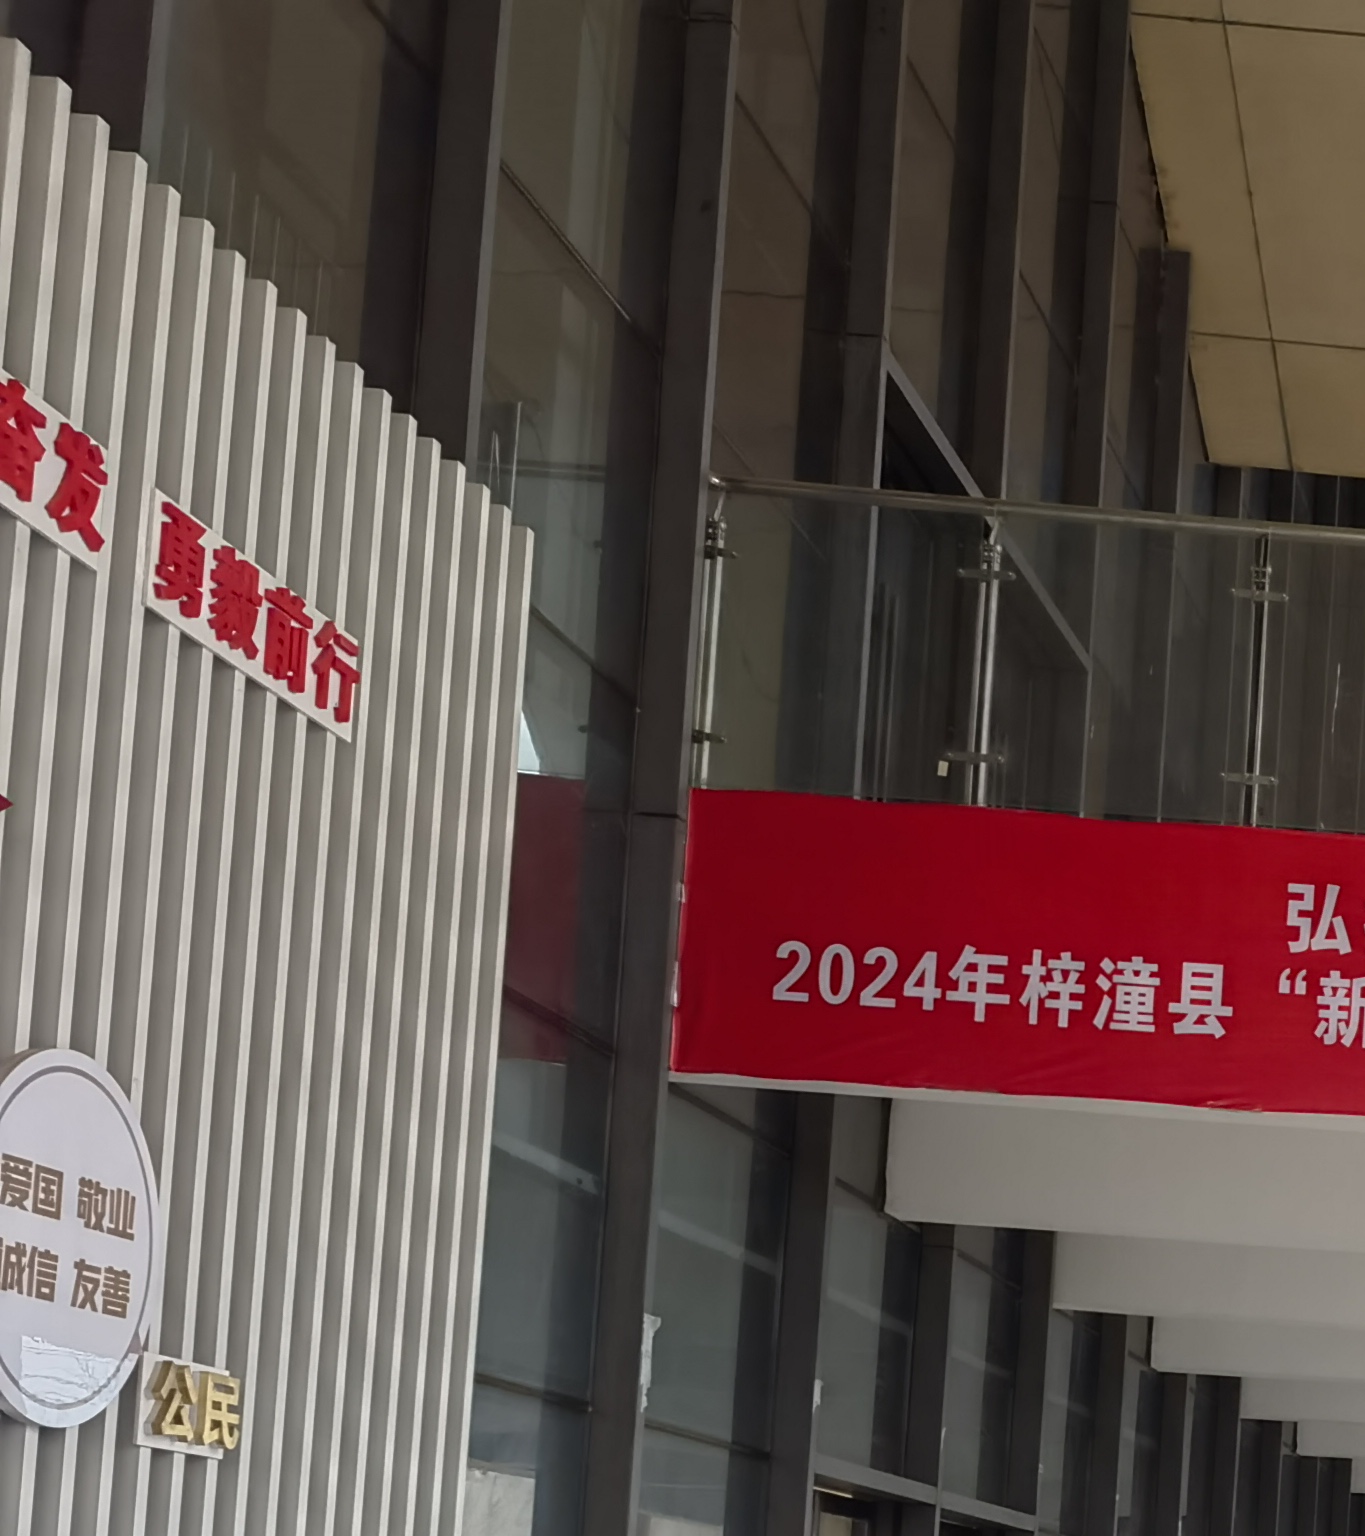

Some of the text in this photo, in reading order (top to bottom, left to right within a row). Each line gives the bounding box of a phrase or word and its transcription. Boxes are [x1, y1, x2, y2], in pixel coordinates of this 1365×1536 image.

[153, 501, 361, 723] 勇毅前行
[774, 941, 1233, 1038] 2024年梓潼县
[0, 1153, 136, 1242] 爱国 敬业
[0, 1237, 131, 1319] 诚信 友善
[145, 1360, 241, 1451] 公民
